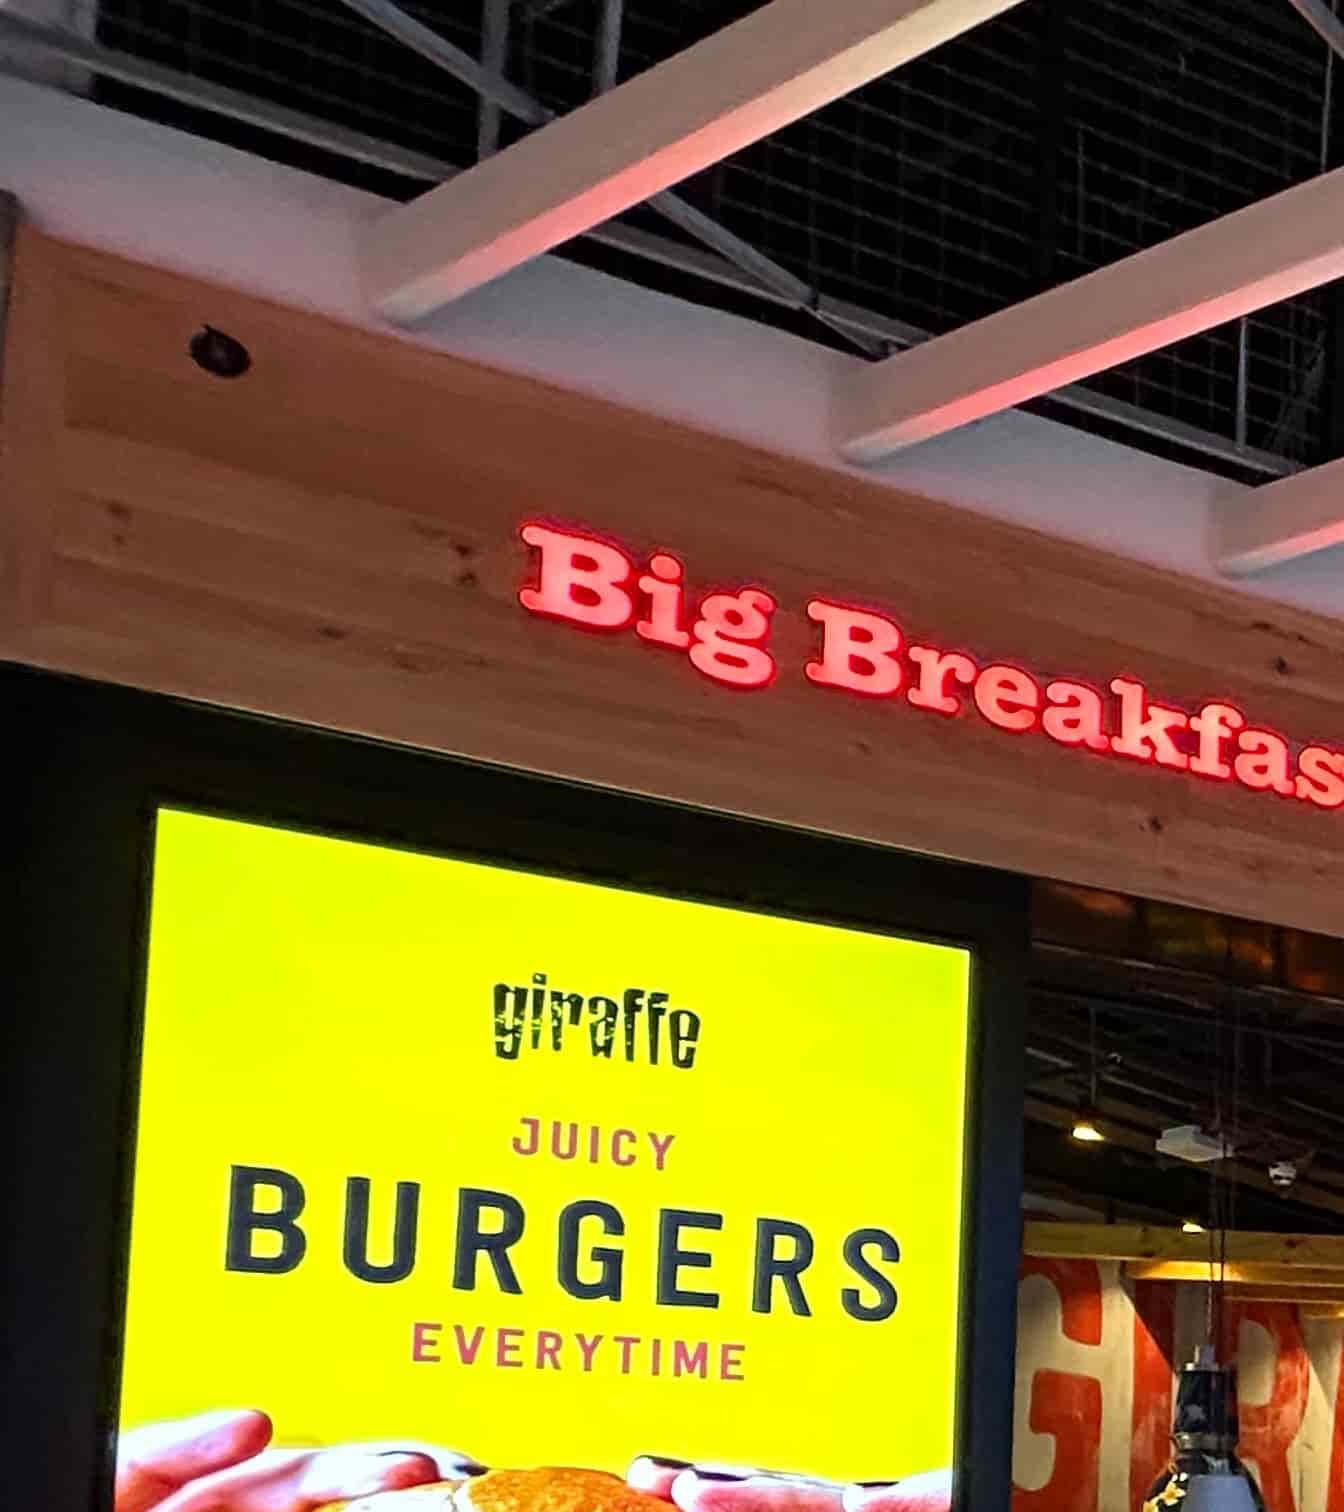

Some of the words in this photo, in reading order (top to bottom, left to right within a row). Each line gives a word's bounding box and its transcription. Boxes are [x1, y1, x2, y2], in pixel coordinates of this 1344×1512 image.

[518, 522, 777, 688] Big
[492, 973, 701, 1069] giraffe
[511, 1117, 677, 1171] JUICY
[223, 1163, 902, 1323] BURGERS
[410, 1321, 747, 1382] EVERYTIME
